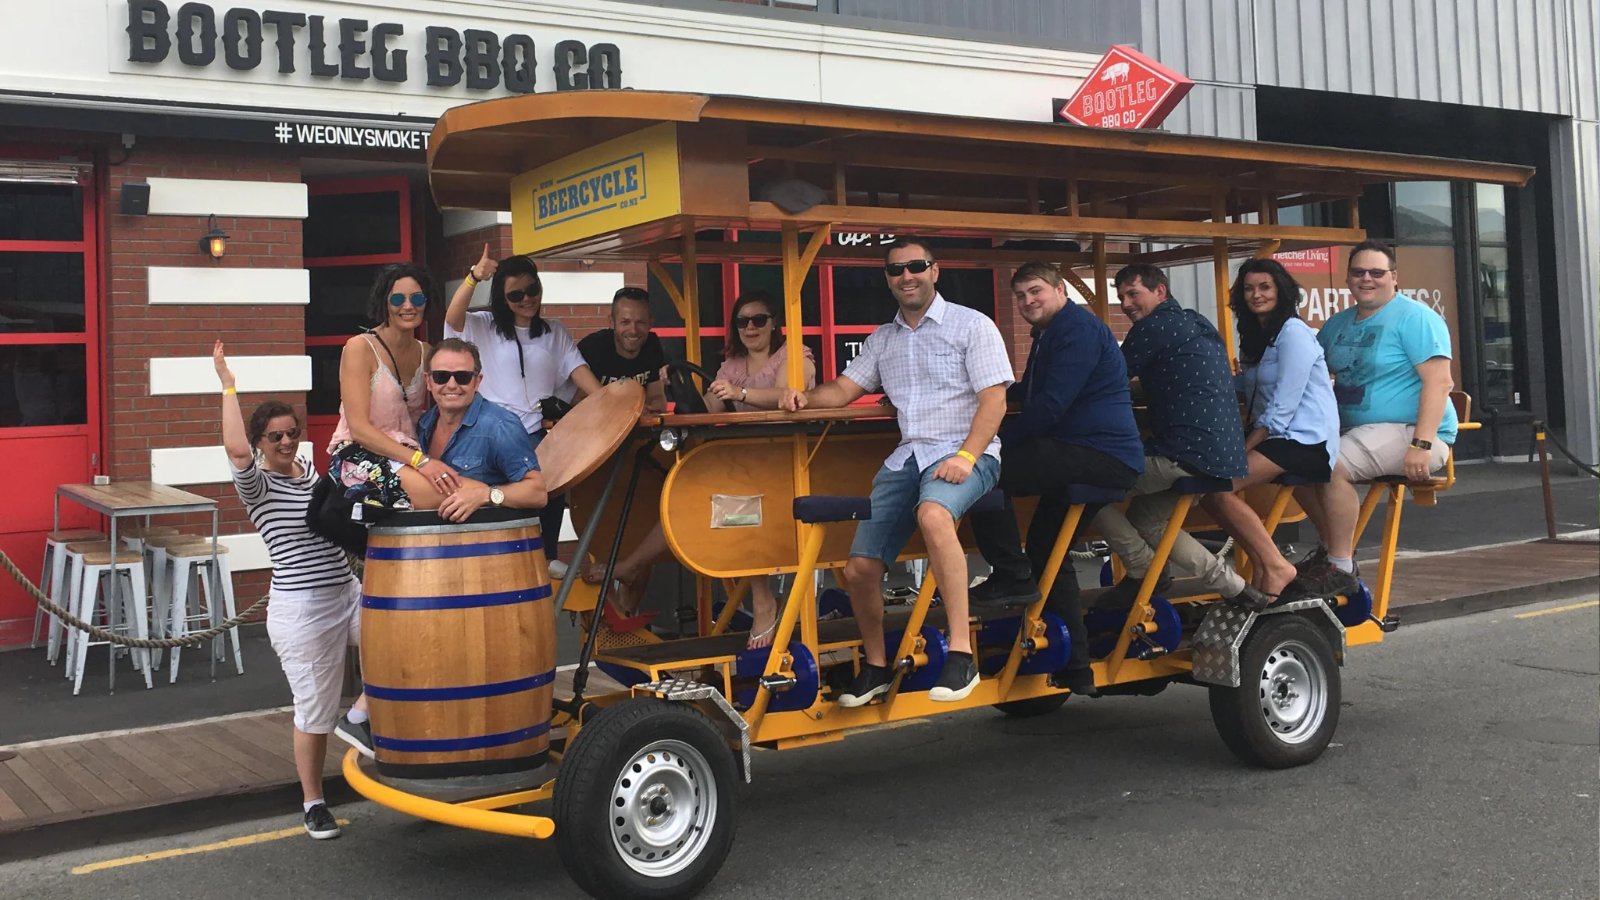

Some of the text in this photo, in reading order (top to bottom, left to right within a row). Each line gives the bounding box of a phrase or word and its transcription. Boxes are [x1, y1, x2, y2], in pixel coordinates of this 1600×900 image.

[126, 0, 634, 93] BOOTLEG BBQ CO
[1082, 78, 1157, 117] BOOTLEG
[1102, 110, 1136, 128] BBQ CO
[538, 165, 638, 219] BEERCYCLE
[1306, 250, 1329, 264] Living
